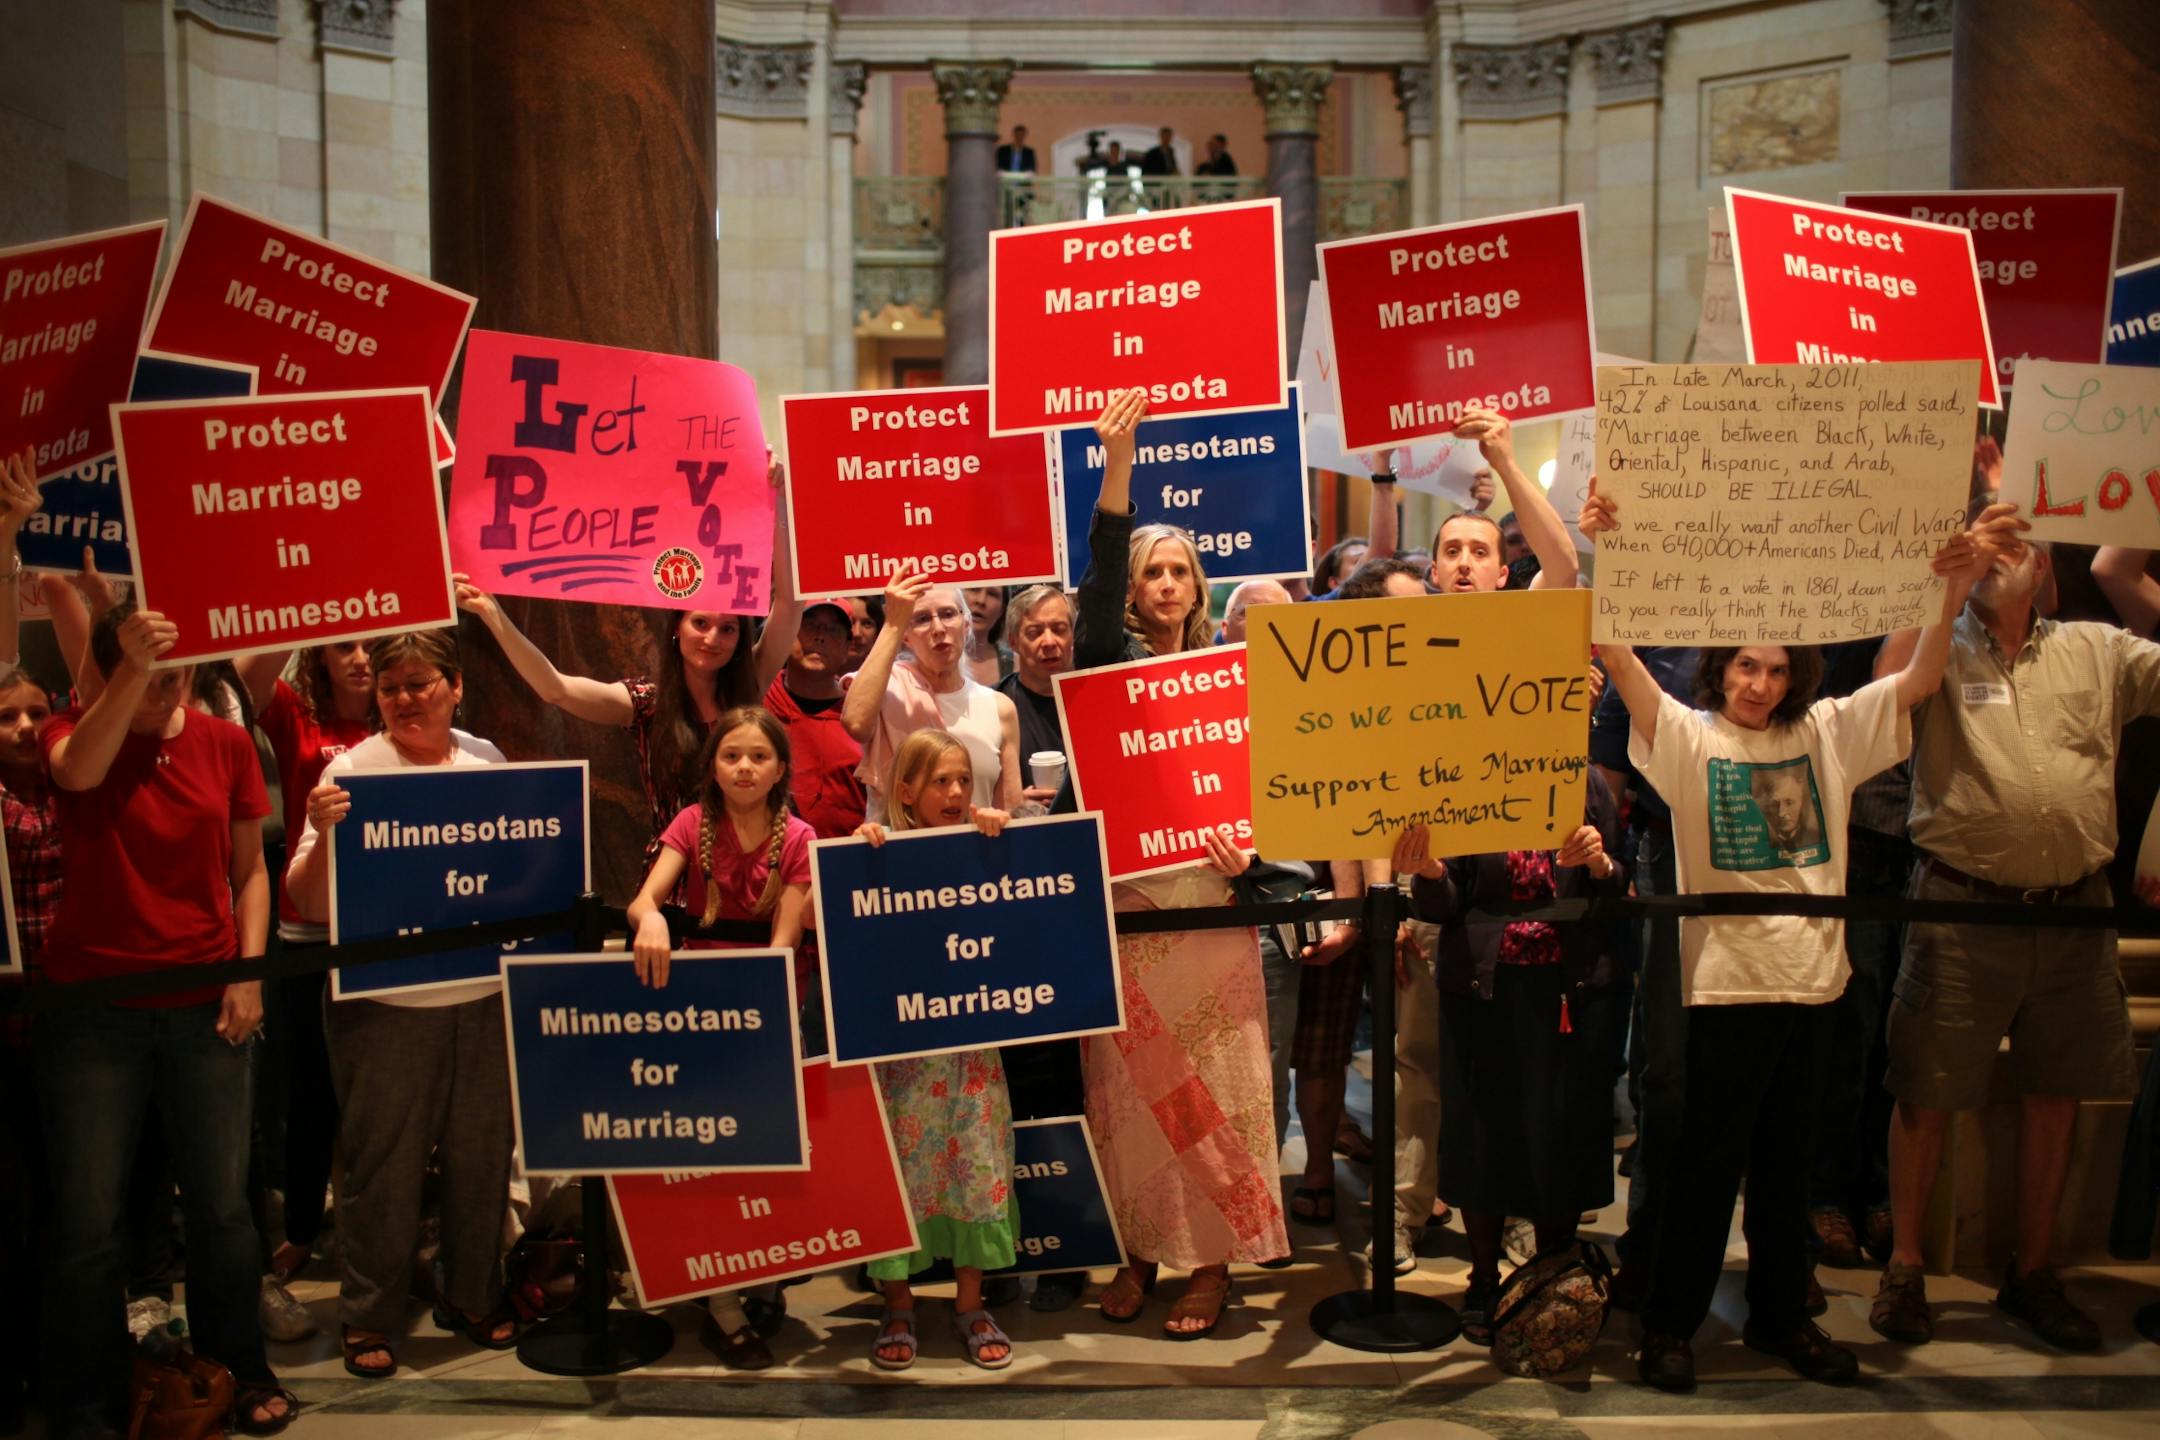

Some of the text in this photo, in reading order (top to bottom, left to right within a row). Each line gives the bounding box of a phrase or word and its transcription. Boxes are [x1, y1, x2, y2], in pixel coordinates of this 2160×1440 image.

[1063, 225, 1192, 264] Protect
[1793, 213, 1904, 253] Protect
[1390, 234, 1509, 275] Protect
[4, 253, 104, 301] Protect
[260, 238, 391, 308] Protect
[1784, 254, 1917, 298] Marriage
[1045, 277, 1201, 314] Marriage
[1378, 289, 1521, 329] Marriage
[224, 279, 378, 357] Marriage
[1849, 306, 1877, 333] in
[0, 318, 97, 364] arriage
[1113, 332, 1143, 356] in
[1446, 345, 1475, 369] in
[274, 354, 307, 386] in
[1619, 367, 1658, 387] In
[1673, 367, 1710, 387] Late
[1721, 367, 1796, 393] March,
[1805, 367, 1863, 392] 2011,
[20, 386, 45, 417] in
[510, 355, 741, 456] Let THE
[850, 402, 970, 431] Protect
[1600, 388, 1966, 421] 42% of Louisana citizens polled said,
[205, 413, 347, 450] Protect
[1721, 418, 1799, 443] between
[1815, 419, 1874, 451] Black,
[1884, 422, 1945, 451] White,
[837, 452, 980, 482] Marriage
[1086, 435, 1276, 469] Mnesotans
[1609, 446, 1895, 479] Oriental, Hispanic, and Arab,
[192, 476, 362, 515] Marriage
[1161, 485, 1204, 509] for
[1637, 481, 1707, 500] SHOULD
[1728, 482, 1754, 500] BE
[19, 512, 130, 549] arria
[904, 502, 933, 526] in
[1633, 519, 1663, 533] we
[1675, 510, 1731, 539] really
[1741, 510, 1784, 535] want
[1788, 509, 1853, 535] another
[1858, 506, 1902, 537] Civil
[1914, 507, 1966, 536] War?
[276, 538, 311, 568] in
[654, 548, 702, 575] Protect Marriage
[844, 546, 1010, 580] Minnesota
[1602, 536, 1650, 553] When
[1843, 537, 1884, 562] Died,
[1891, 538, 1952, 561] AGAI
[1609, 570, 1640, 589] If
[1652, 570, 1685, 592] left
[1697, 573, 1712, 594] to
[1719, 586, 1731, 596] a
[1743, 574, 1773, 595] vote
[1782, 579, 1795, 596] in
[1806, 576, 1843, 601] 1861,
[208, 589, 401, 640] Minnesota
[1600, 595, 1924, 626] Do you really think the Blacks would
[1612, 620, 1652, 640] have
[1664, 628, 1701, 640] ever
[1709, 620, 1747, 640] been
[1818, 628, 1838, 639] as
[1846, 610, 1928, 637] SLAVES?
[1268, 617, 1408, 682] VOTE
[1126, 661, 1246, 704] Protect
[1295, 673, 1586, 735] so we can VOTE
[1119, 716, 1249, 757] Marriag
[1191, 770, 1222, 795] in
[1266, 750, 1589, 809] Support the Marriage
[363, 815, 562, 849] Minnesotans
[1138, 818, 1252, 858] Minnes
[446, 870, 489, 897] for
[851, 872, 1076, 918] Minnesotans
[945, 933, 994, 961] for
[896, 982, 1055, 1022] Marriage
[540, 1005, 762, 1036] Minnesotans
[630, 1058, 679, 1087] for
[582, 1111, 738, 1144] Marriage
[738, 1194, 772, 1220] in
[685, 1226, 862, 1282] Minnesota
